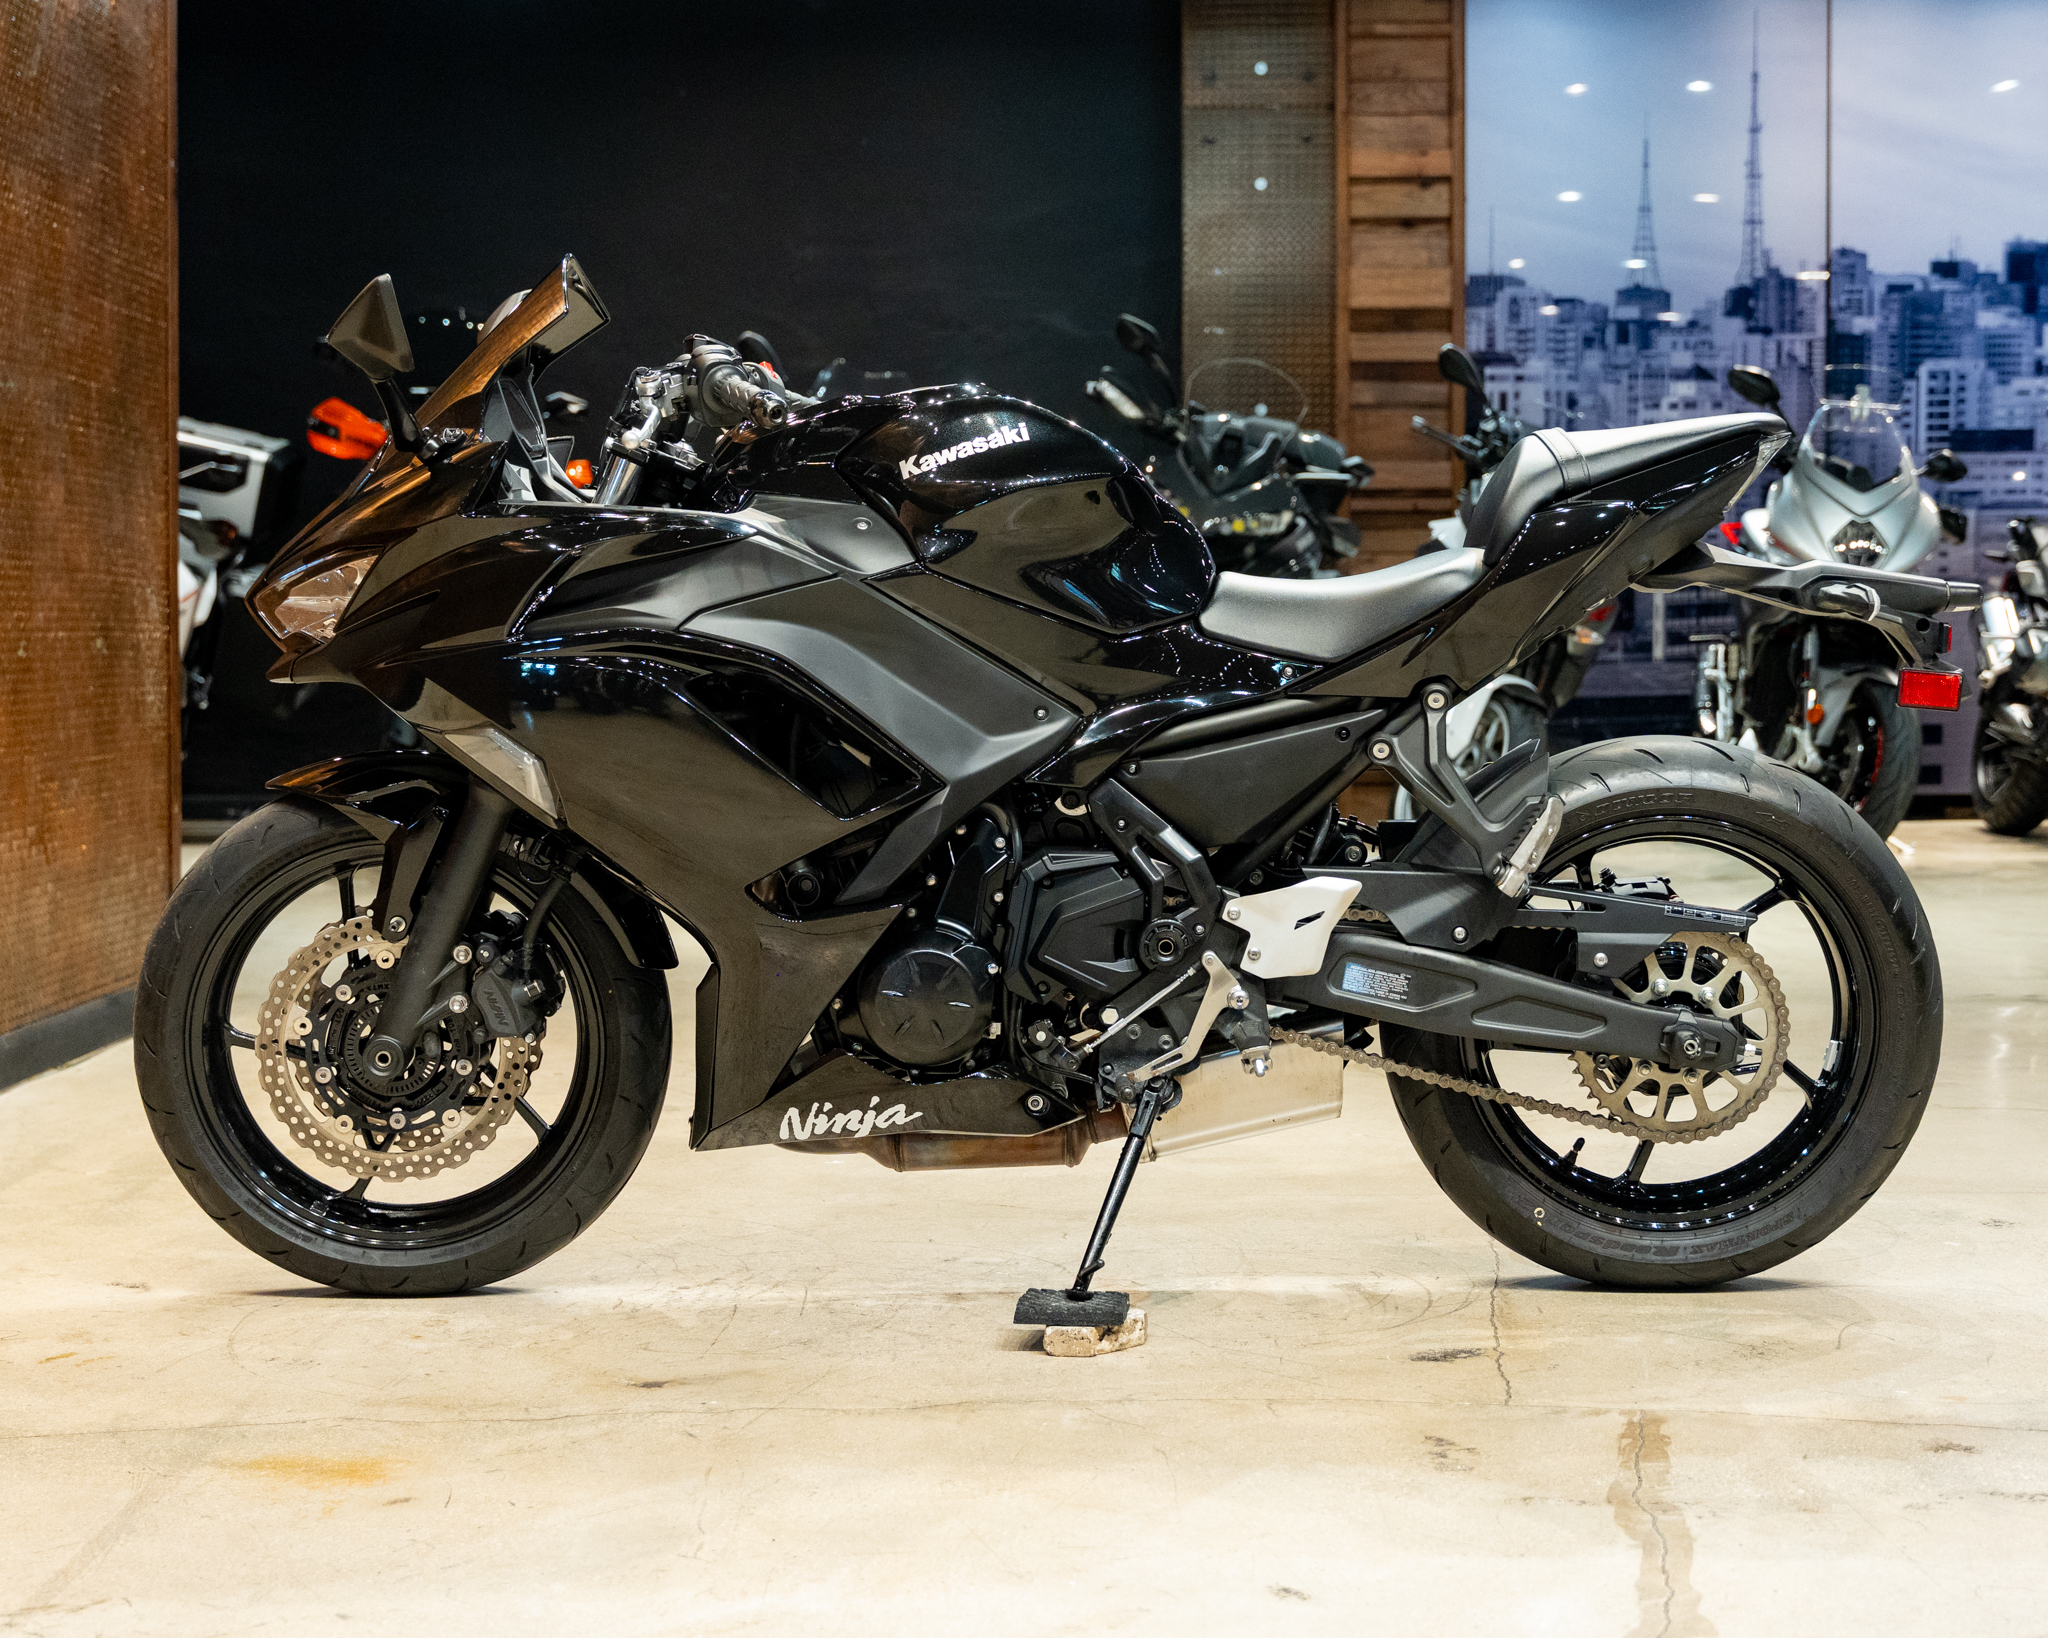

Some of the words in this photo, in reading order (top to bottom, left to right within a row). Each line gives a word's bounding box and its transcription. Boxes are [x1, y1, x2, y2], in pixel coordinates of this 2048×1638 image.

[898, 422, 1031, 479] Kawasaki
[482, 988, 509, 1026] NISSIN
[779, 1095, 924, 1141] Ninja
